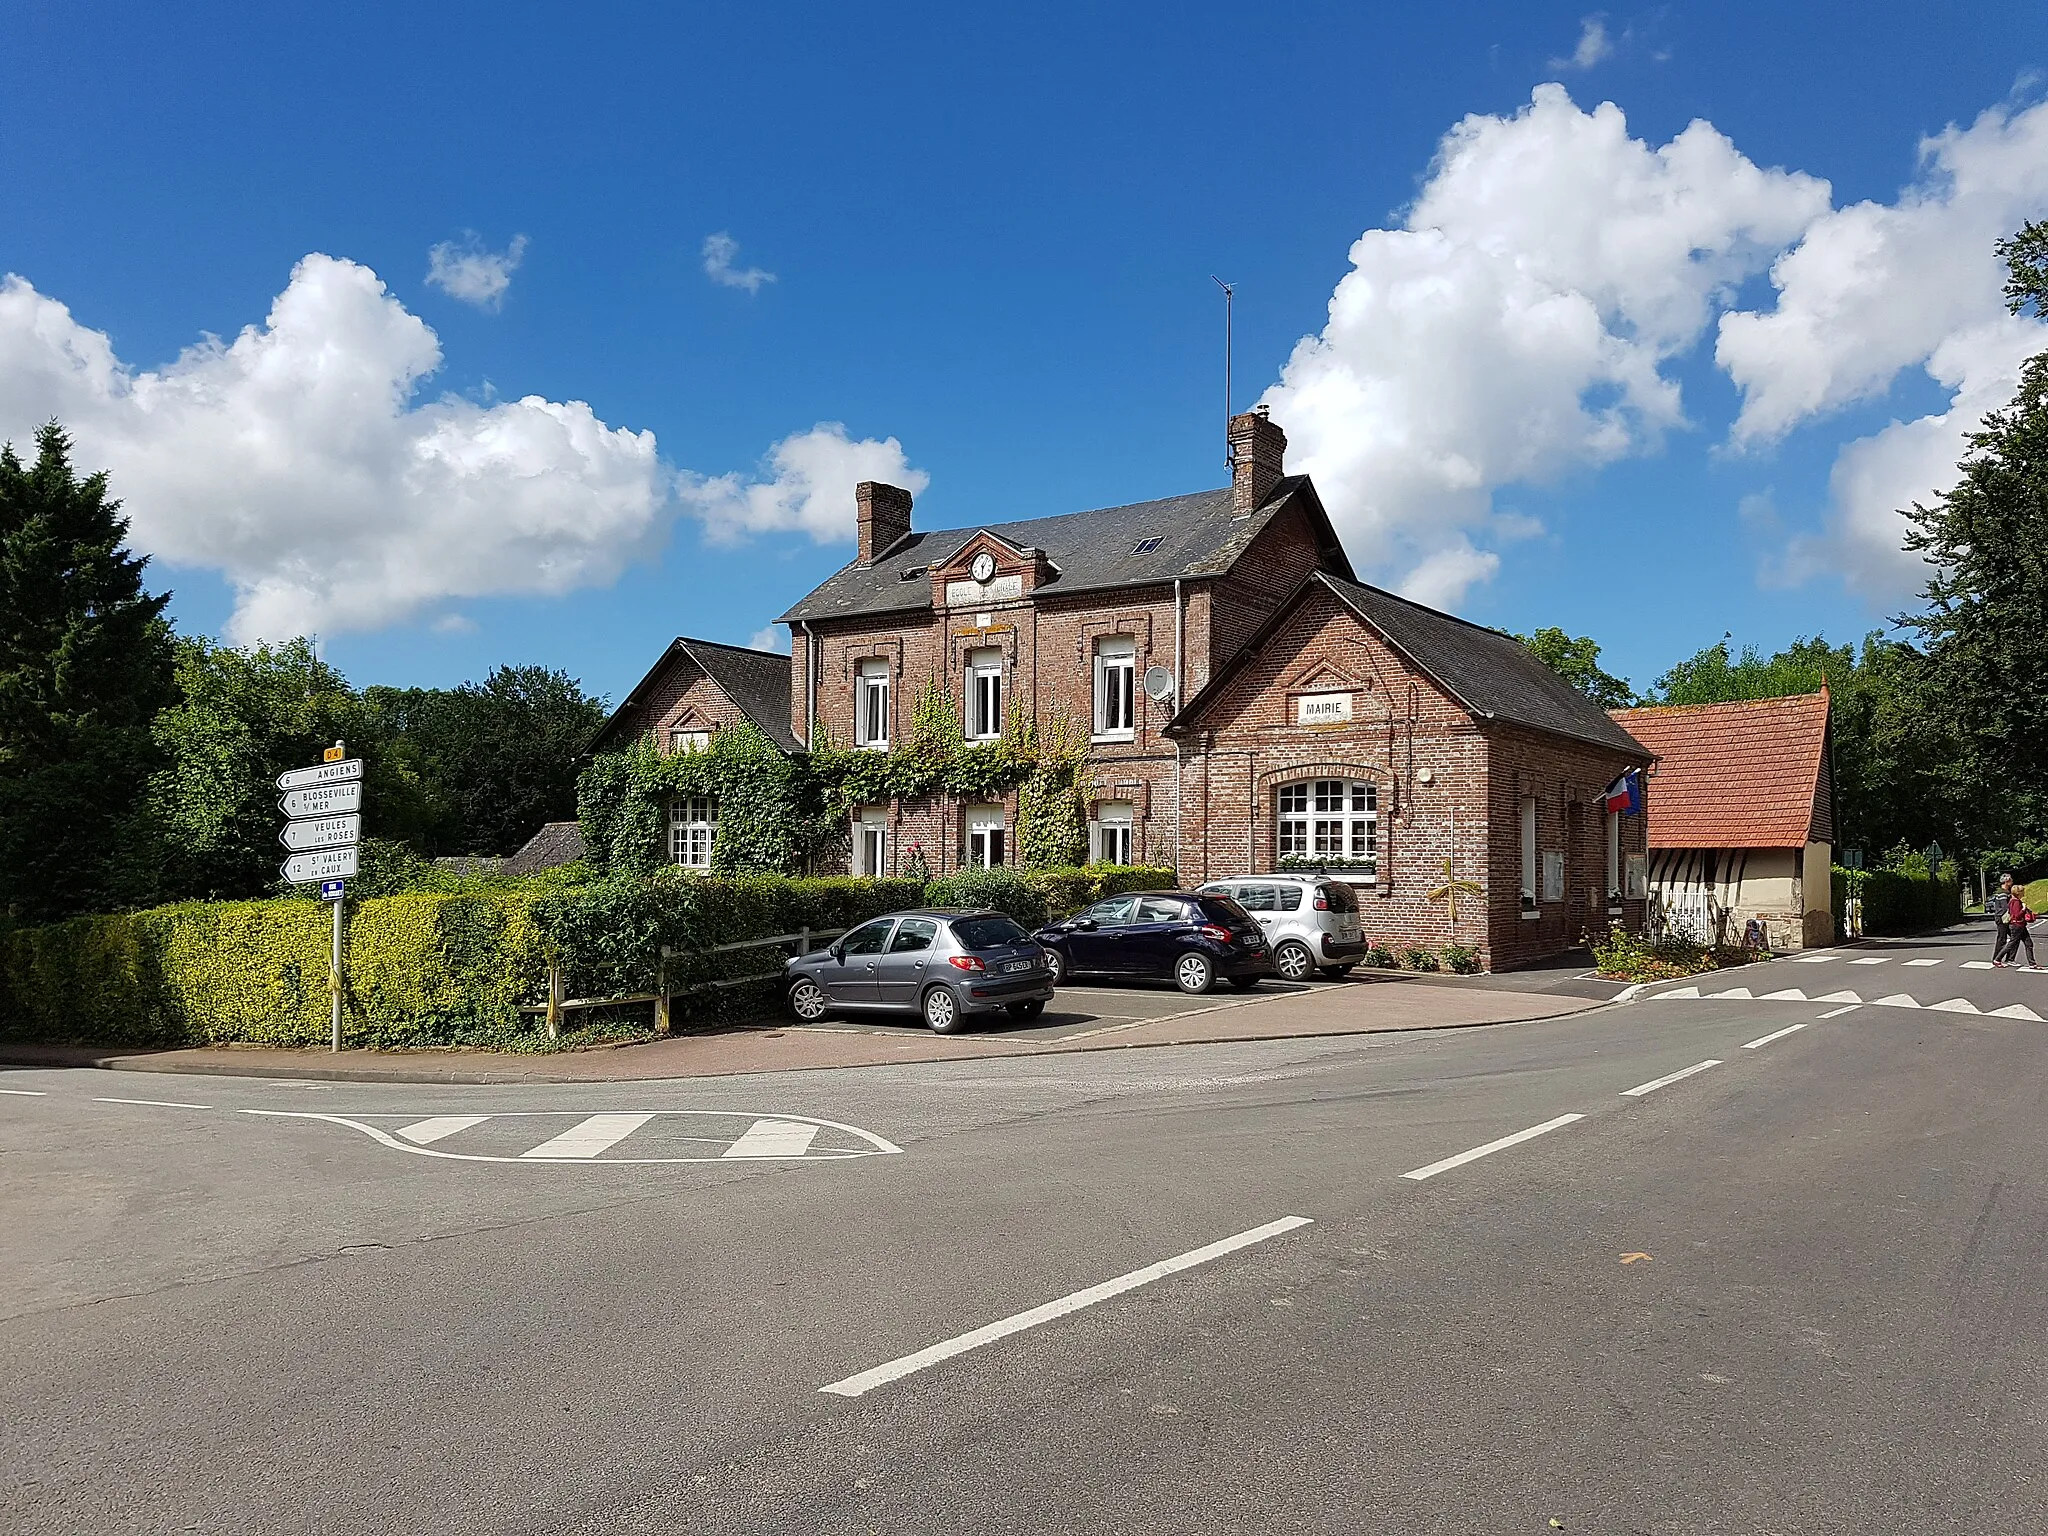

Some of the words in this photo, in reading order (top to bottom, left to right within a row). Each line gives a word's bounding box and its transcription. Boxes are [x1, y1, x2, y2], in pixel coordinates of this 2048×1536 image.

[1306, 702, 1342, 715] MAIRIE
[327, 751, 331, 759] D
[317, 764, 357, 779] ANGIENS
[285, 776, 290, 784] 6
[303, 787, 355, 801] BLOSSEVILLE
[291, 799, 296, 808] 6
[312, 801, 329, 811] MER
[314, 820, 346, 832] VEULES
[291, 832, 296, 840] 7
[327, 830, 354, 841] ROSES
[322, 851, 353, 863] VALERY
[292, 864, 301, 873] 12
[321, 864, 341, 875] CAUX
